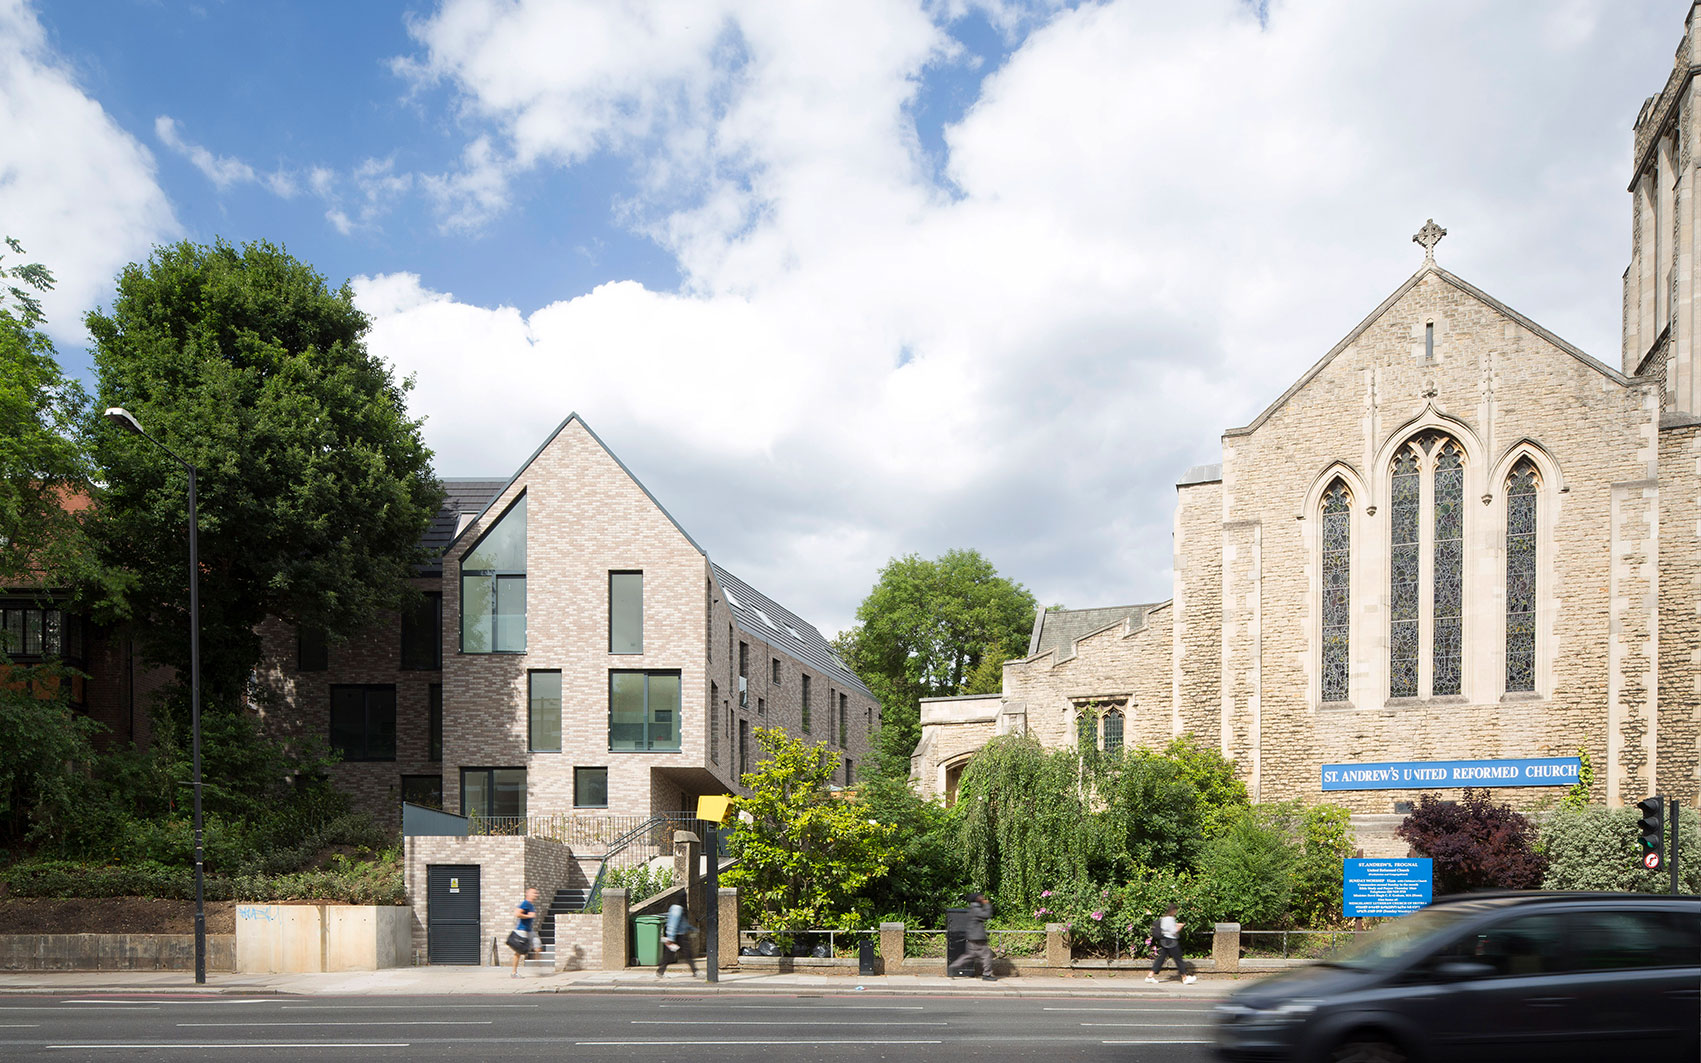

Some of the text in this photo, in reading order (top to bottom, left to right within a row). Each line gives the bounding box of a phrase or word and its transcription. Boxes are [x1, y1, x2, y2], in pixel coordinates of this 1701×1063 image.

[1324, 764, 1578, 783] ST. ANDREW'S UNITED REFORMED CHURCH
